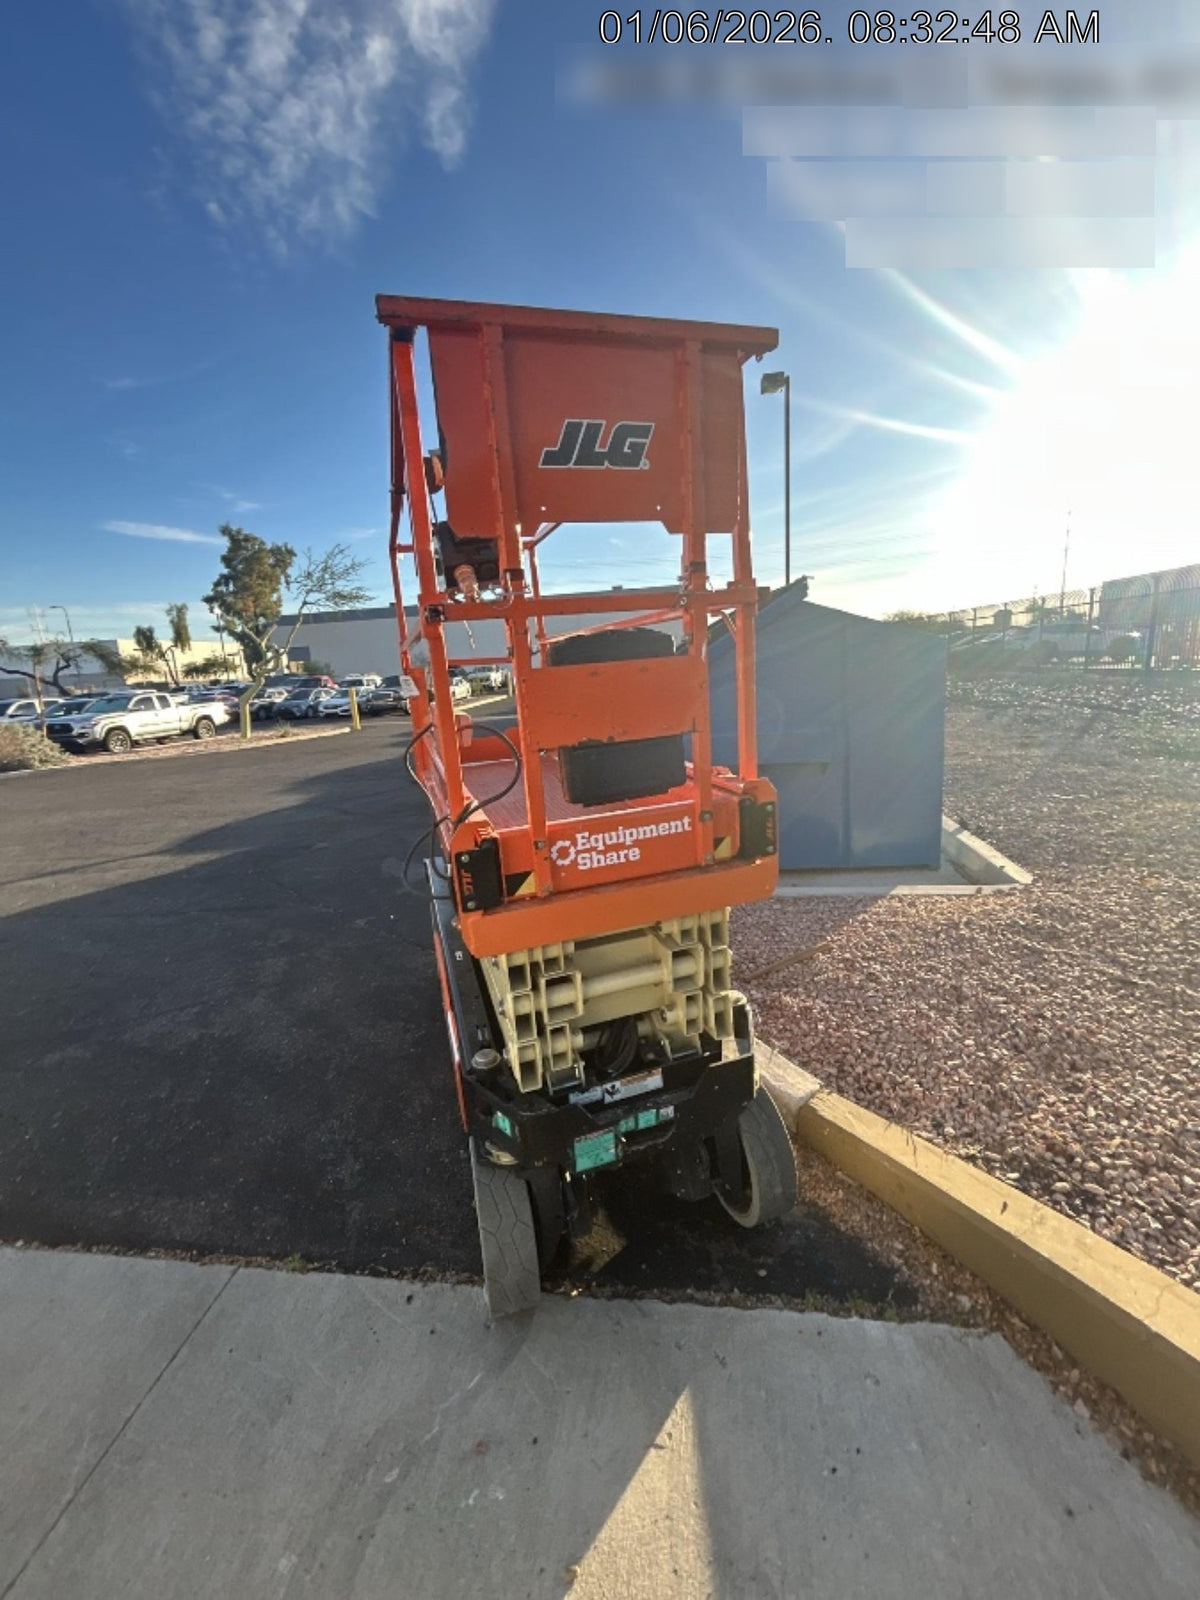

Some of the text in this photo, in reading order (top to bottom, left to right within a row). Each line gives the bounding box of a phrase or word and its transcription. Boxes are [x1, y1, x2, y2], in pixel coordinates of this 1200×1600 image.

[538, 418, 655, 470] JLG
[575, 815, 692, 851] Equipment
[577, 847, 641, 870] Share
